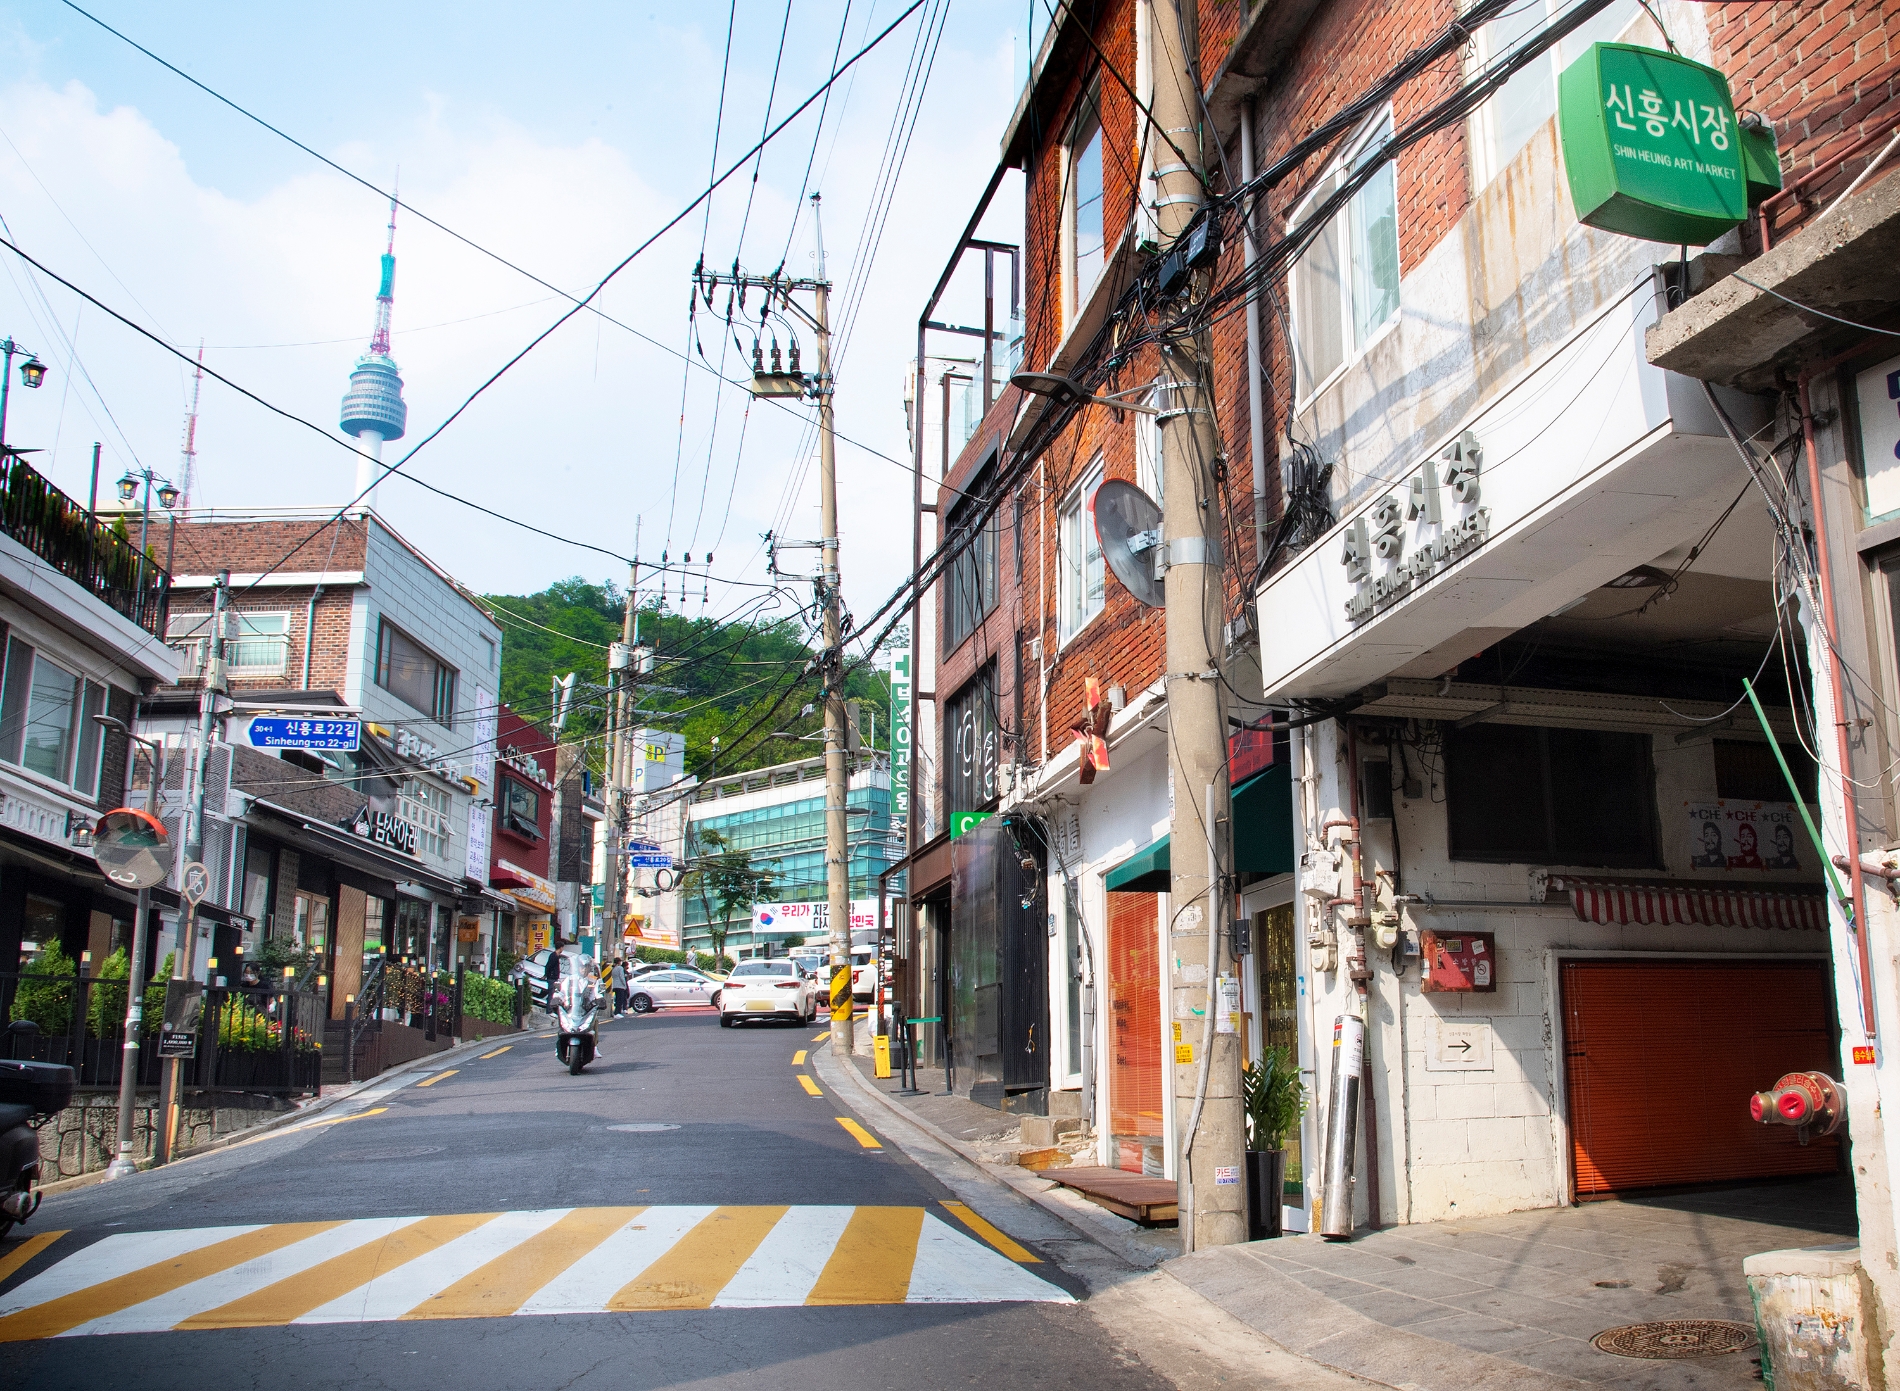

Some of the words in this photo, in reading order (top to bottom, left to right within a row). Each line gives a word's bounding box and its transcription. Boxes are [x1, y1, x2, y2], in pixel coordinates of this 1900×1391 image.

[1606, 83, 1730, 151] 신흥시장
[1613, 143, 1637, 160] SHIN
[1638, 149, 1672, 167] HEUNG
[1674, 157, 1694, 171] ART
[1695, 163, 1736, 180] MARKET
[1340, 430, 1482, 583] 신흥시장
[1344, 593, 1372, 622] SHIN
[1367, 564, 1408, 607] HEUNG
[1432, 506, 1489, 563] MARKET
[265, 736, 325, 748] Sinheung-ro
[327, 738, 355, 749] 22-gil
[285, 721, 357, 738] 신흥로22길
[635, 768, 644, 782] P
[375, 811, 419, 855] 남산아래
[781, 905, 810, 917] 우리가
